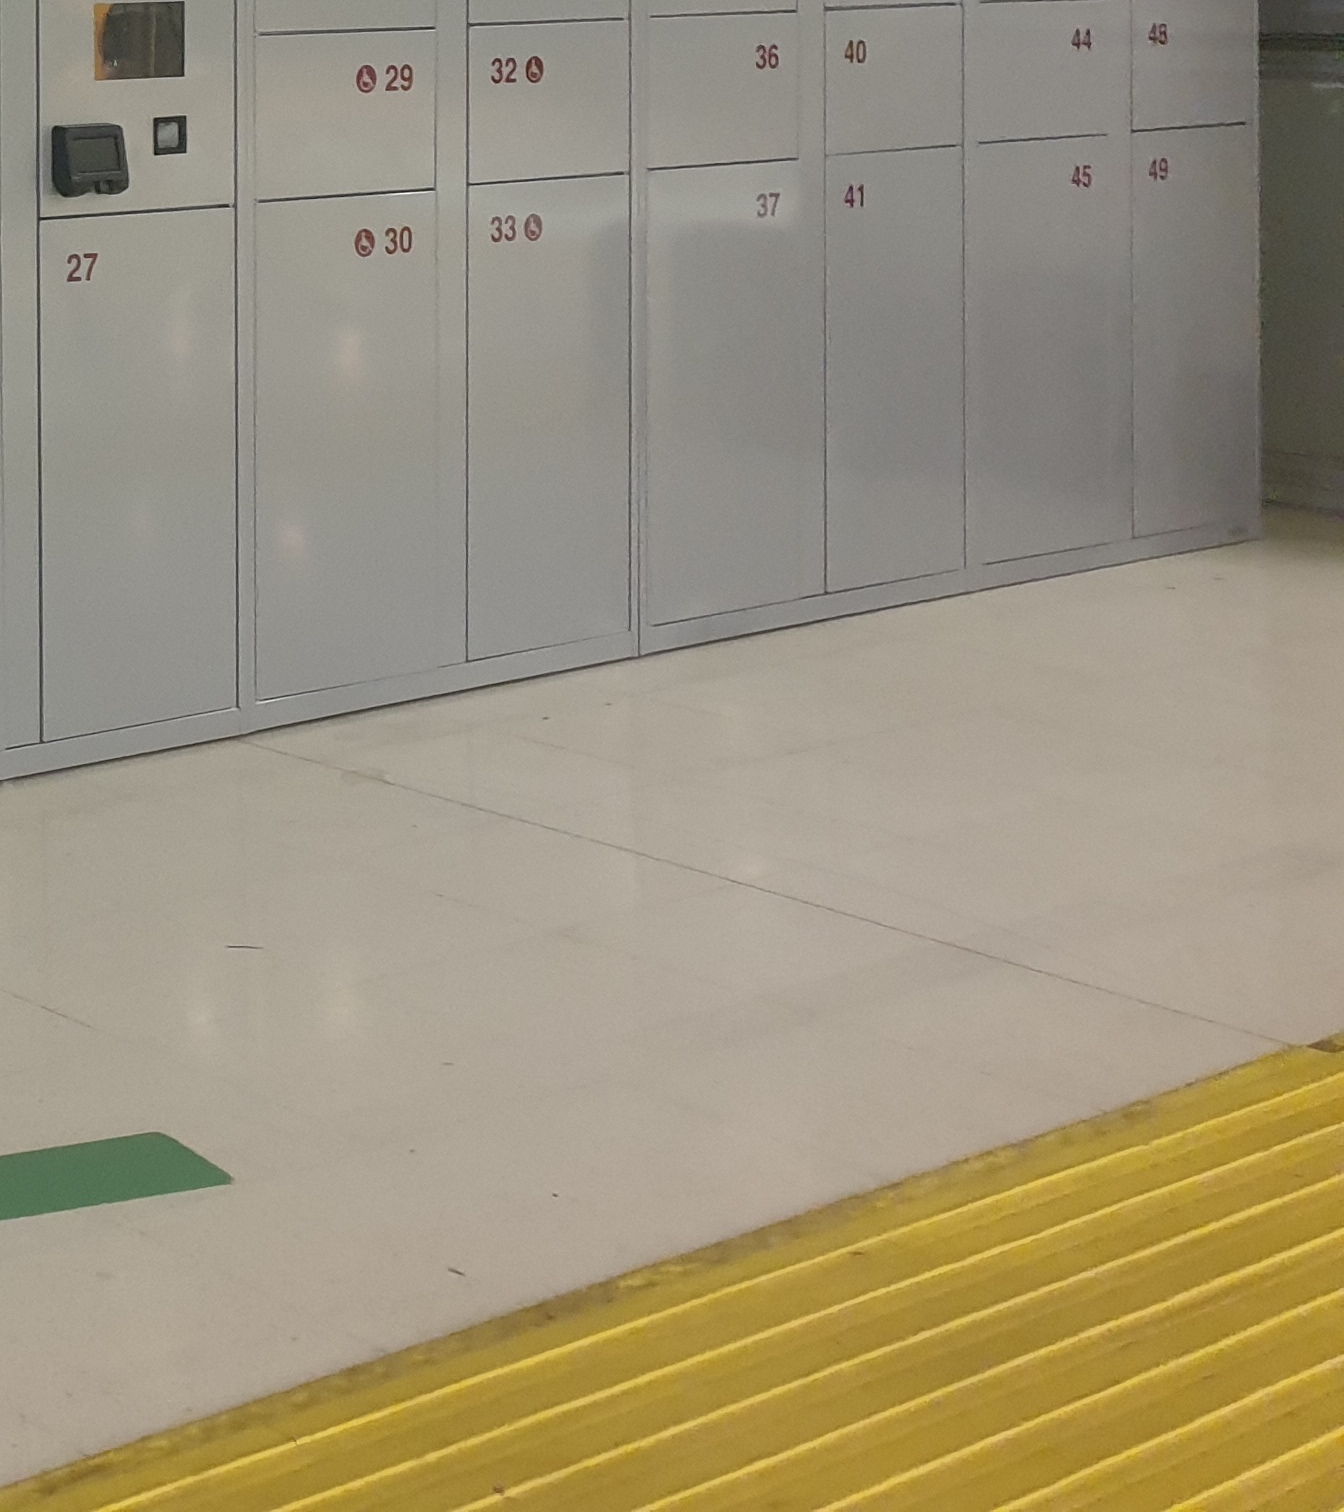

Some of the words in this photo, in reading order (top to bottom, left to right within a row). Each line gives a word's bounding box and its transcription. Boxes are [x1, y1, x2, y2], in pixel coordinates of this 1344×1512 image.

[1071, 29, 1093, 51] 44
[1147, 24, 1169, 46] 48
[755, 44, 780, 70] 36
[843, 40, 867, 64] 40
[384, 64, 414, 92] 29
[490, 58, 518, 85] 32
[1070, 165, 1093, 189] 45
[1148, 158, 1169, 181] 49
[756, 192, 781, 219] 37
[843, 185, 865, 209] 41
[384, 226, 413, 255] 30
[490, 216, 517, 243] 33
[66, 253, 99, 283] 27
